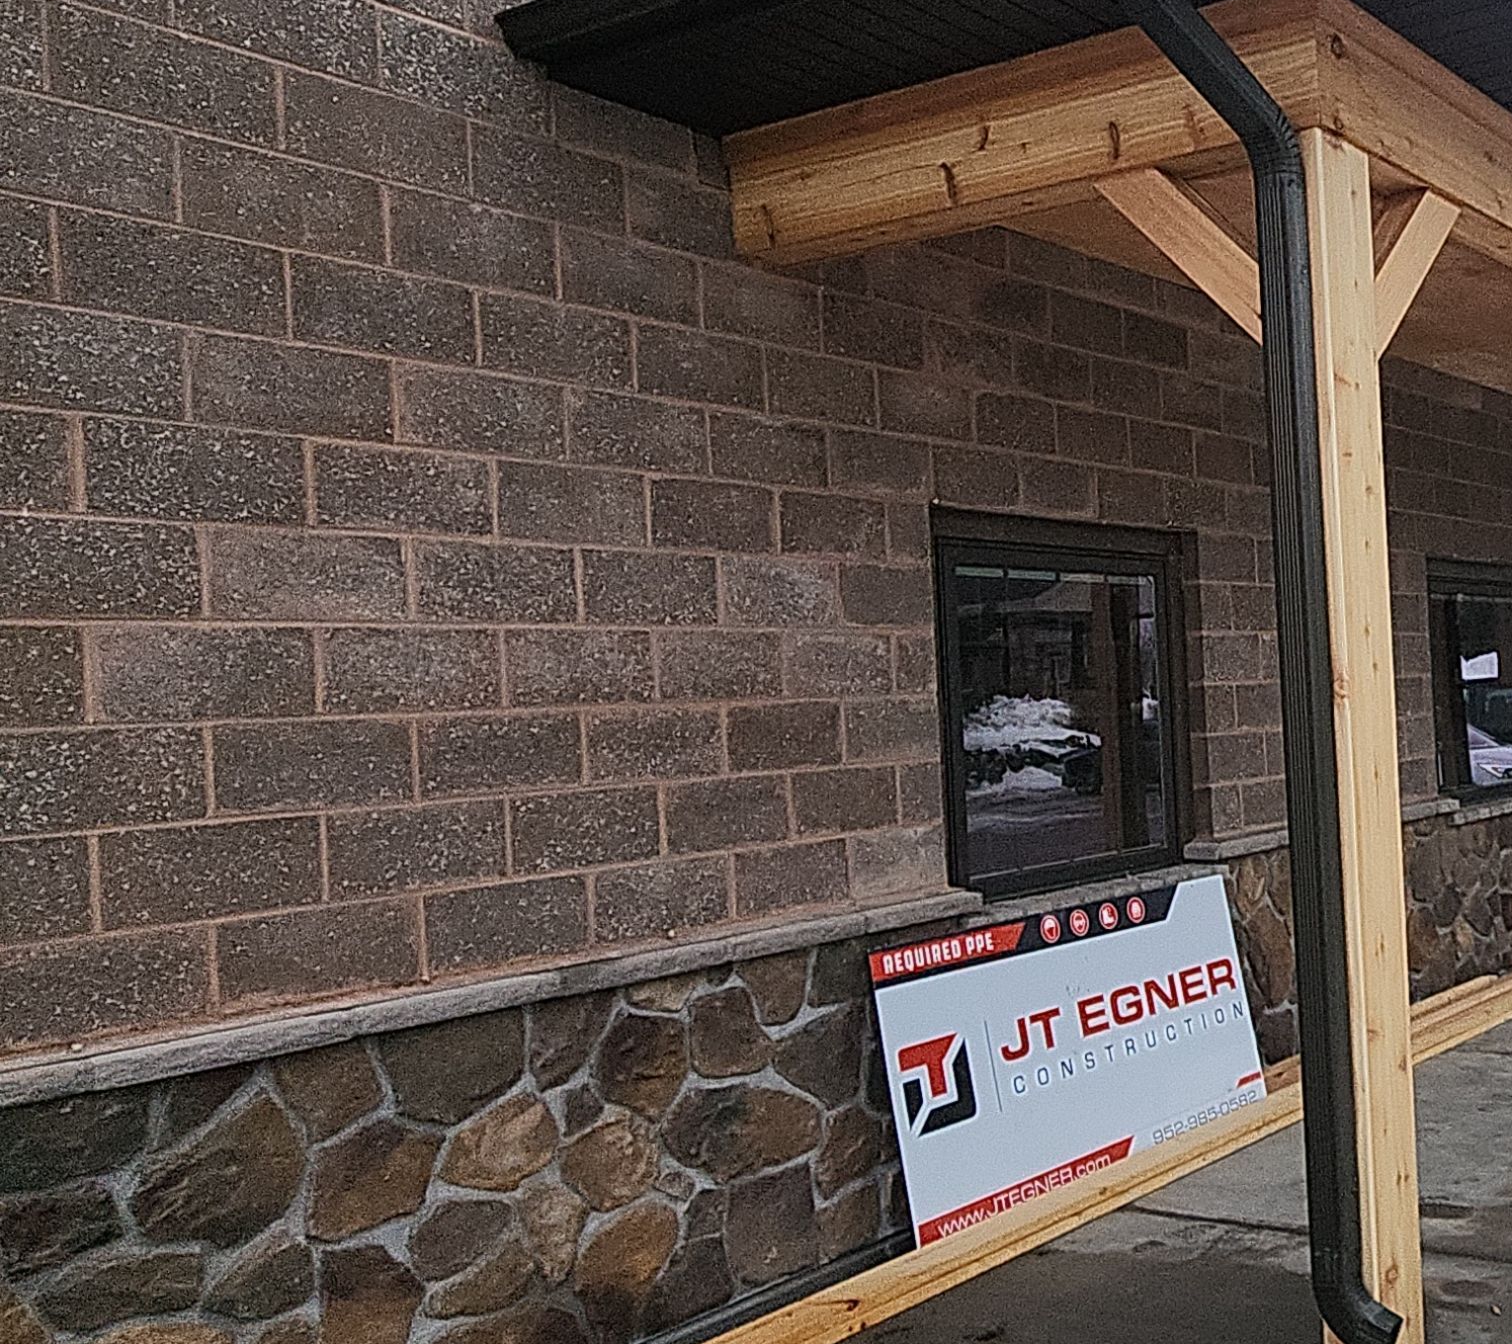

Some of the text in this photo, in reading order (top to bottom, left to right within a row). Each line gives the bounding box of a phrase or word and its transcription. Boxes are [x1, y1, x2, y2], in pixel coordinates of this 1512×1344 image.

[882, 932, 994, 974] REQUIRED PPE
[1000, 957, 1237, 1062] JT EGNER
[1012, 1000, 1245, 1095] CONSTRUCTION
